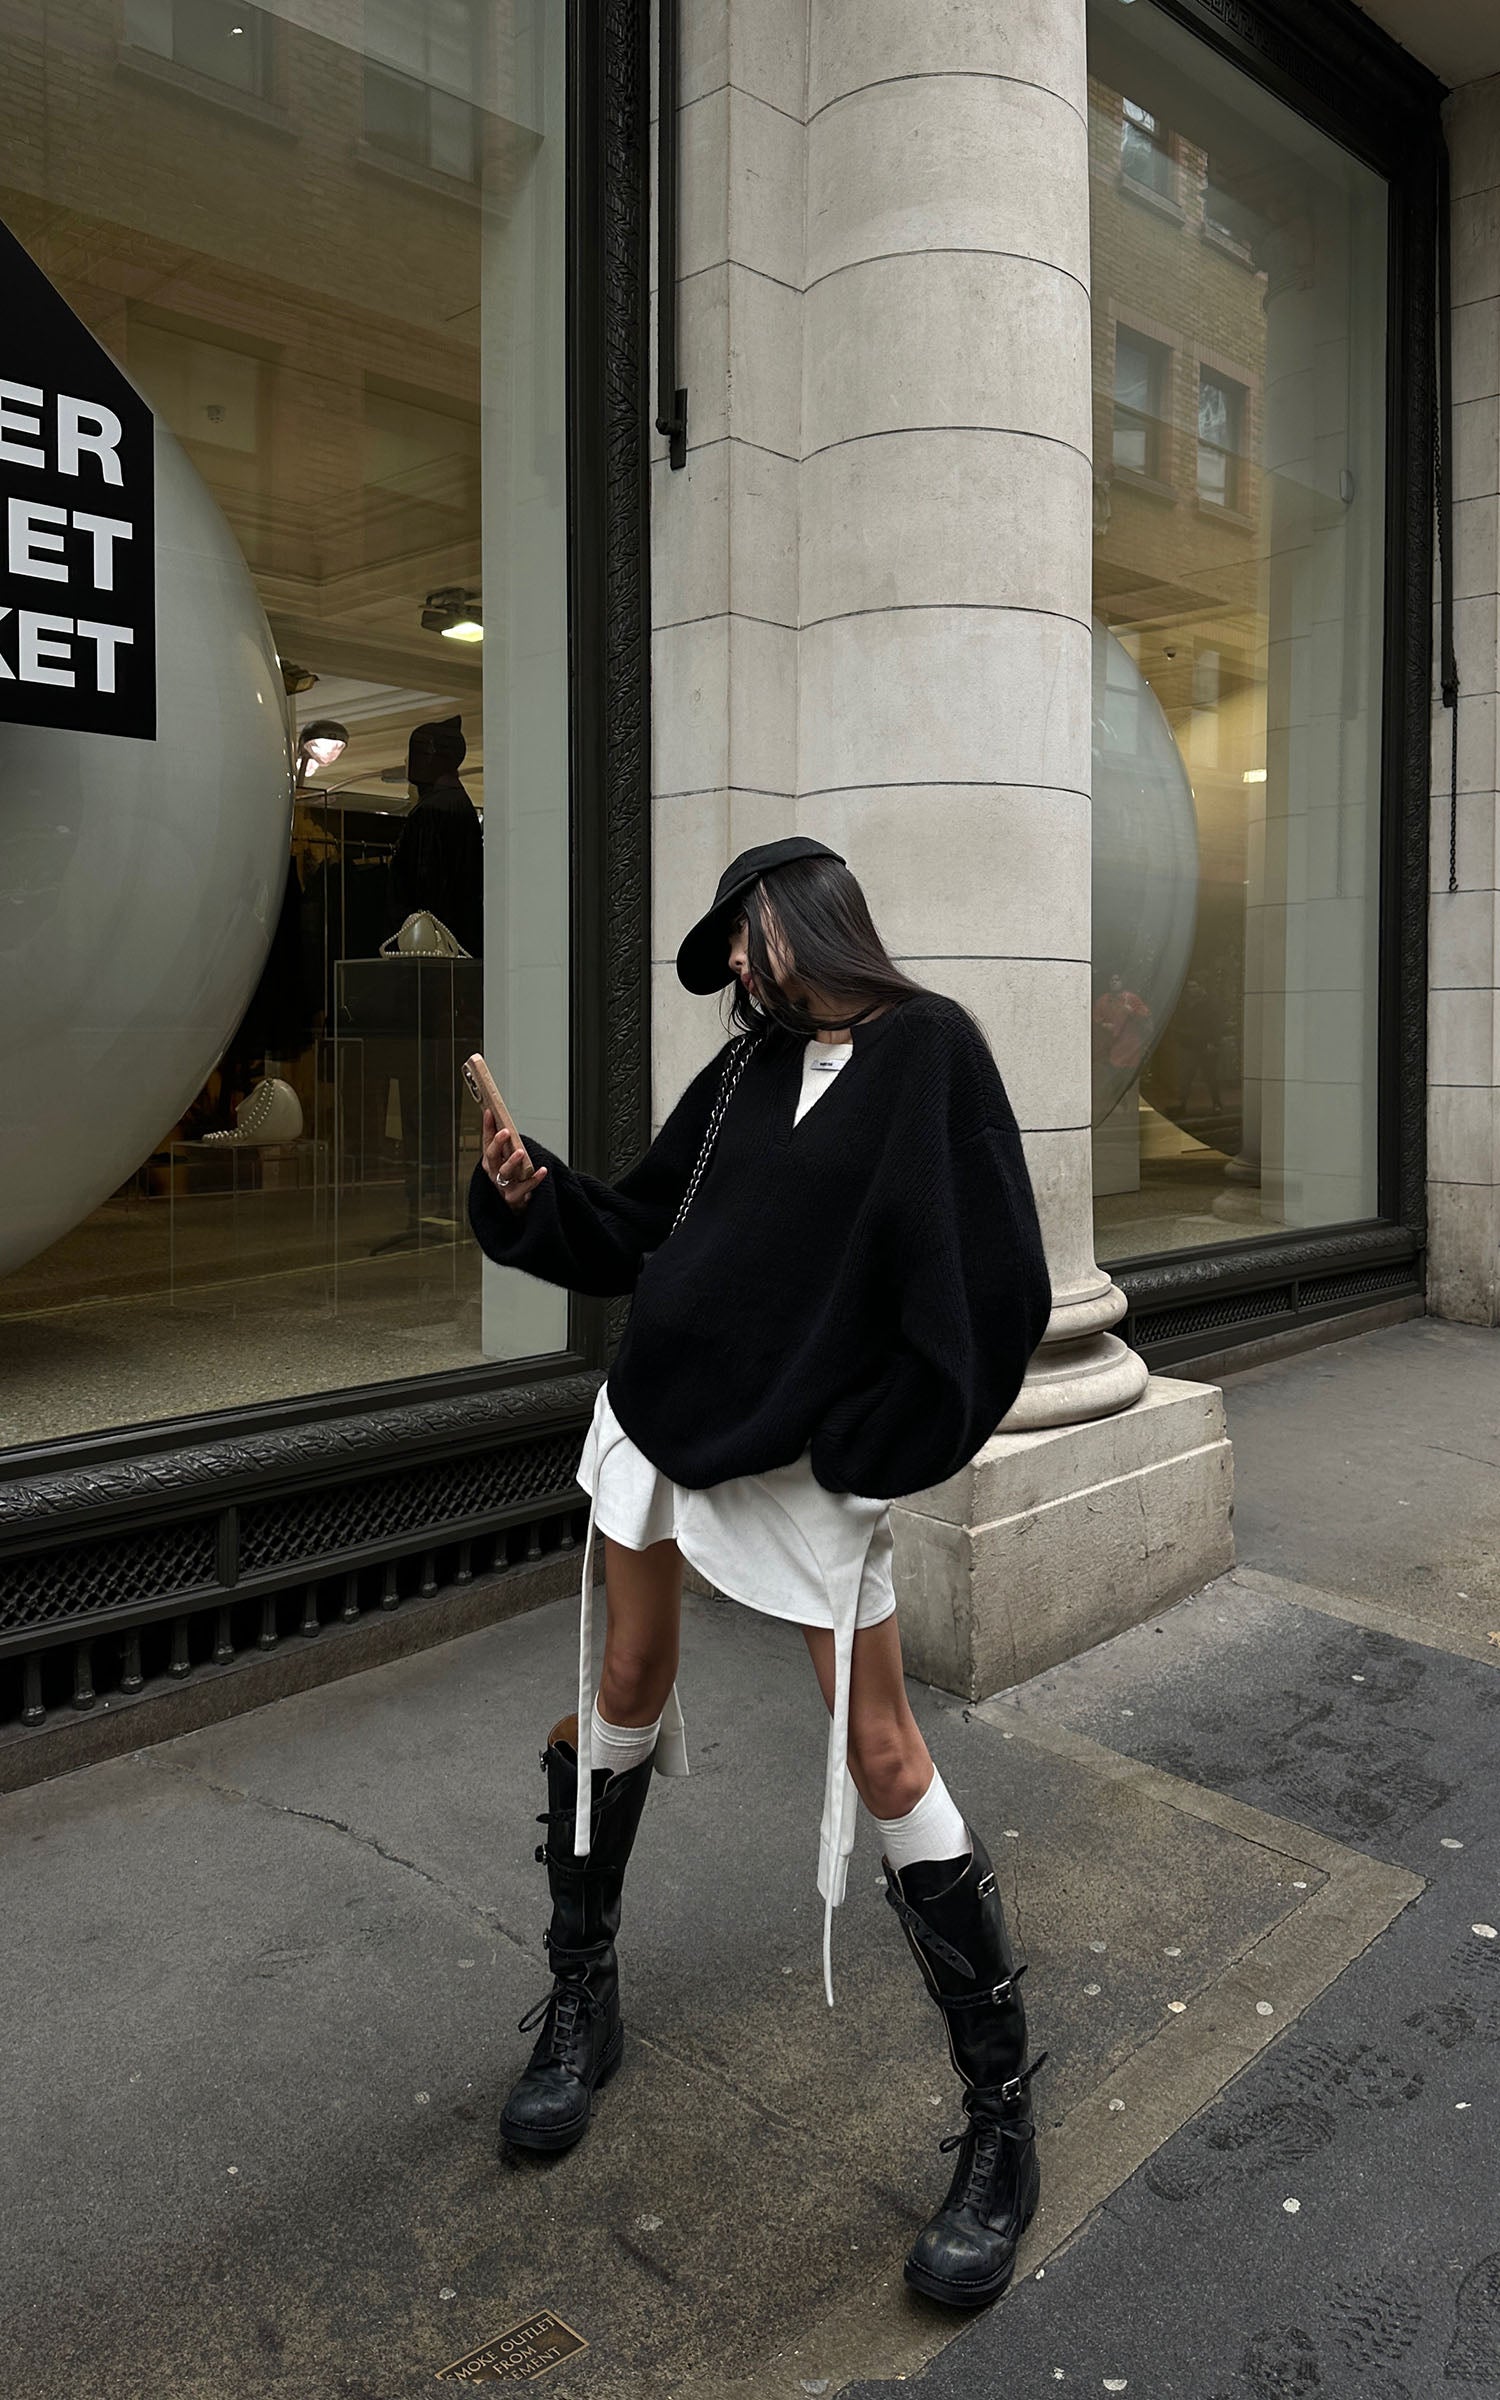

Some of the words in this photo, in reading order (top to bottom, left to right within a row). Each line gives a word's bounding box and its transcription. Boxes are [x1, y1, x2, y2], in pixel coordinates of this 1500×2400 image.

[0, 379, 124, 486] ER
[8, 497, 133, 591] ET
[0, 607, 134, 693] ET
[492, 2345, 537, 2375] FROM
[500, 2316, 556, 2352] OUTLET
